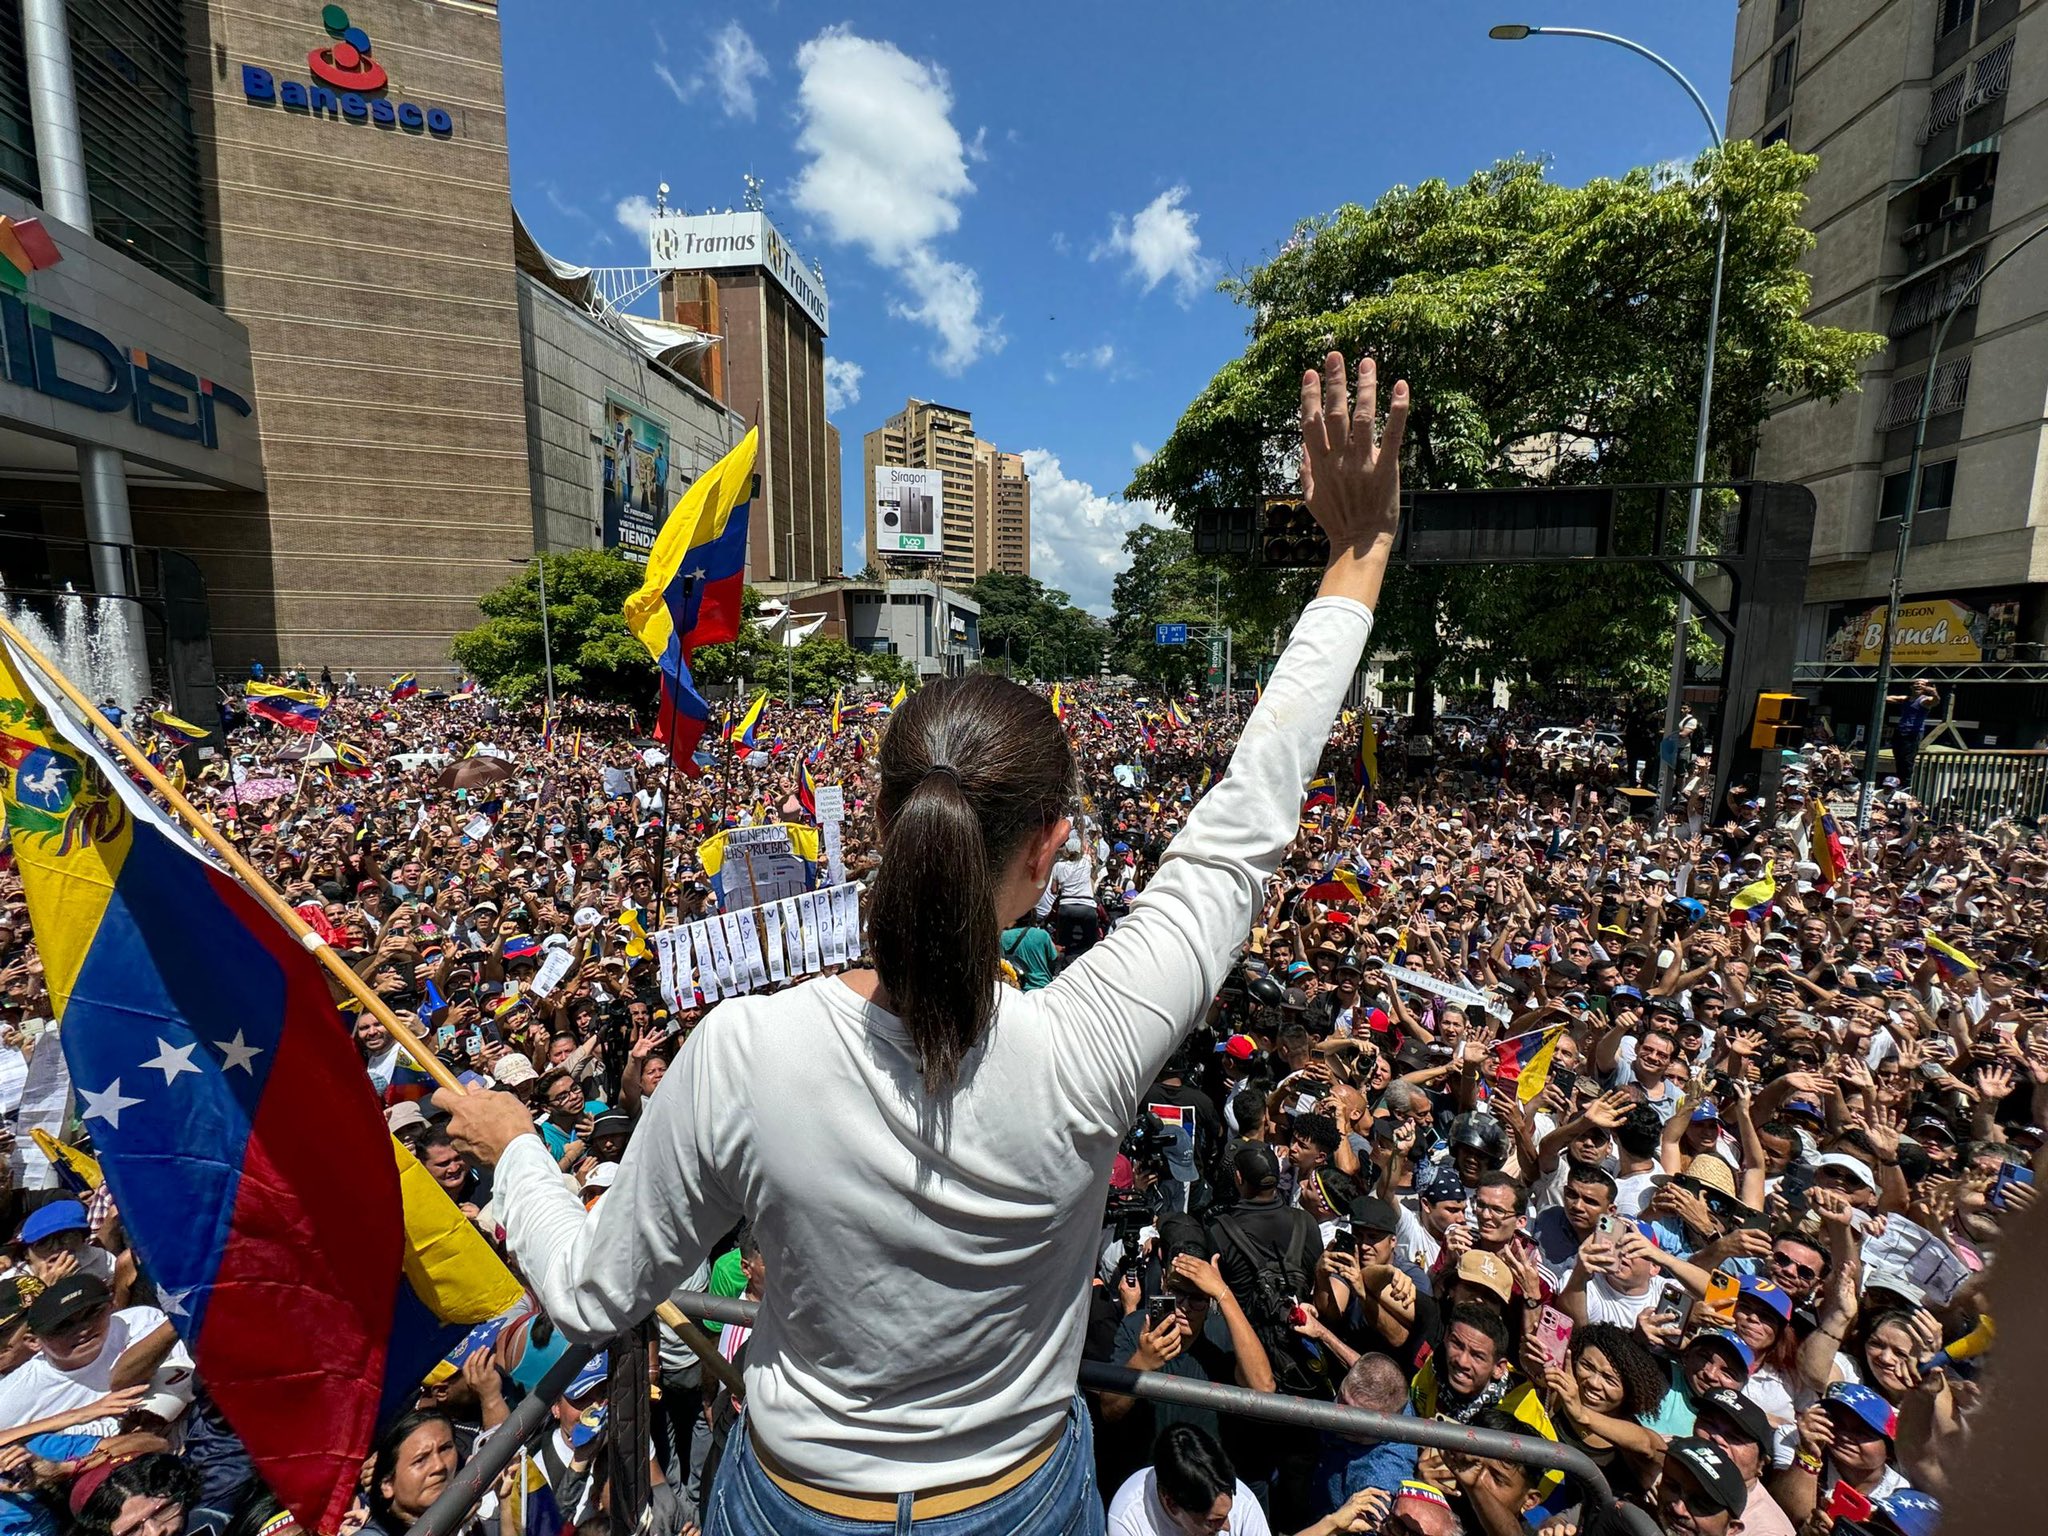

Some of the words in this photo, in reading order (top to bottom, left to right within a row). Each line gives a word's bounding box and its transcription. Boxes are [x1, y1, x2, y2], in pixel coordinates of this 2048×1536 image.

[241, 64, 453, 132] Banesco
[685, 232, 756, 255] Tramas
[783, 247, 826, 323] Tramas
[891, 469, 927, 485] Síragon
[1883, 606, 1936, 619] BDEGON
[1863, 618, 1949, 650] Bruch
[725, 846, 744, 860] LAS
[745, 841, 791, 857] PRUEBAS
